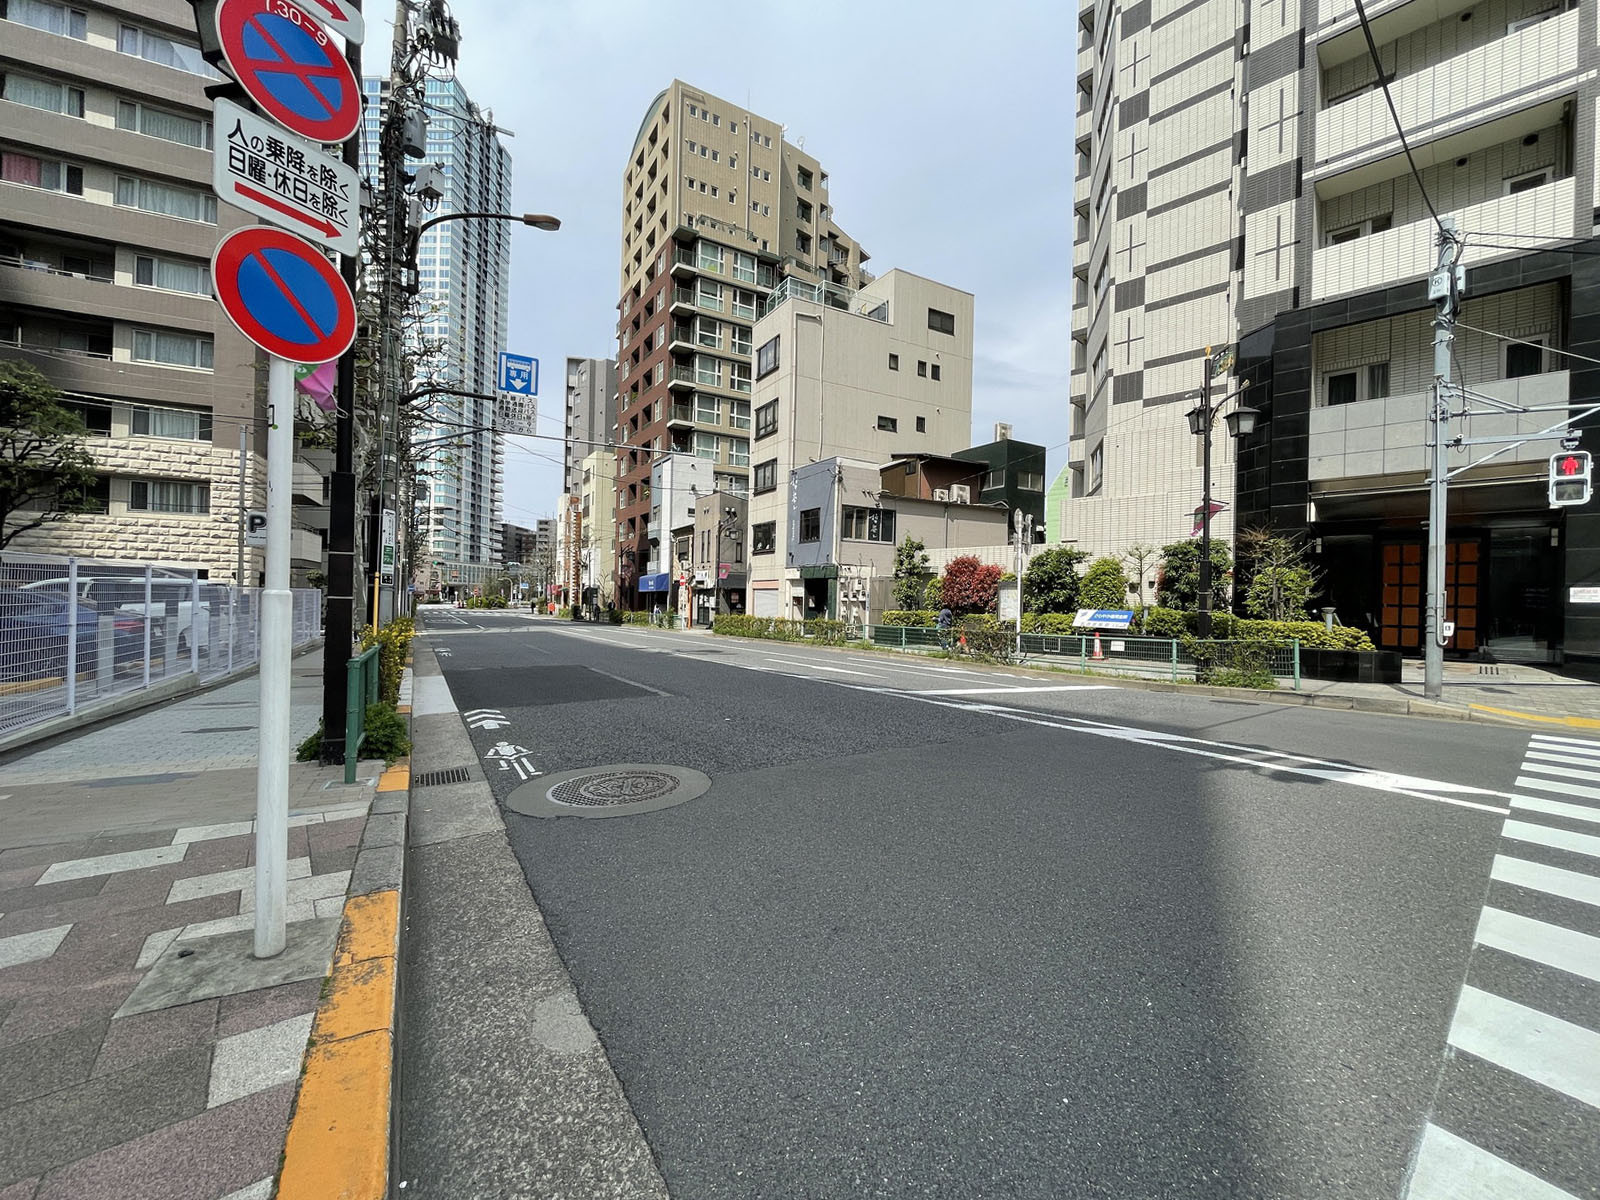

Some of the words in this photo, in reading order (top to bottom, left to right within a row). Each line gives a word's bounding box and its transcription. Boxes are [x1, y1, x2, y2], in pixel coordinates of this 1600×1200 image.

[227, 118, 349, 199] 人の乗降を除く
[249, 514, 267, 533] P
